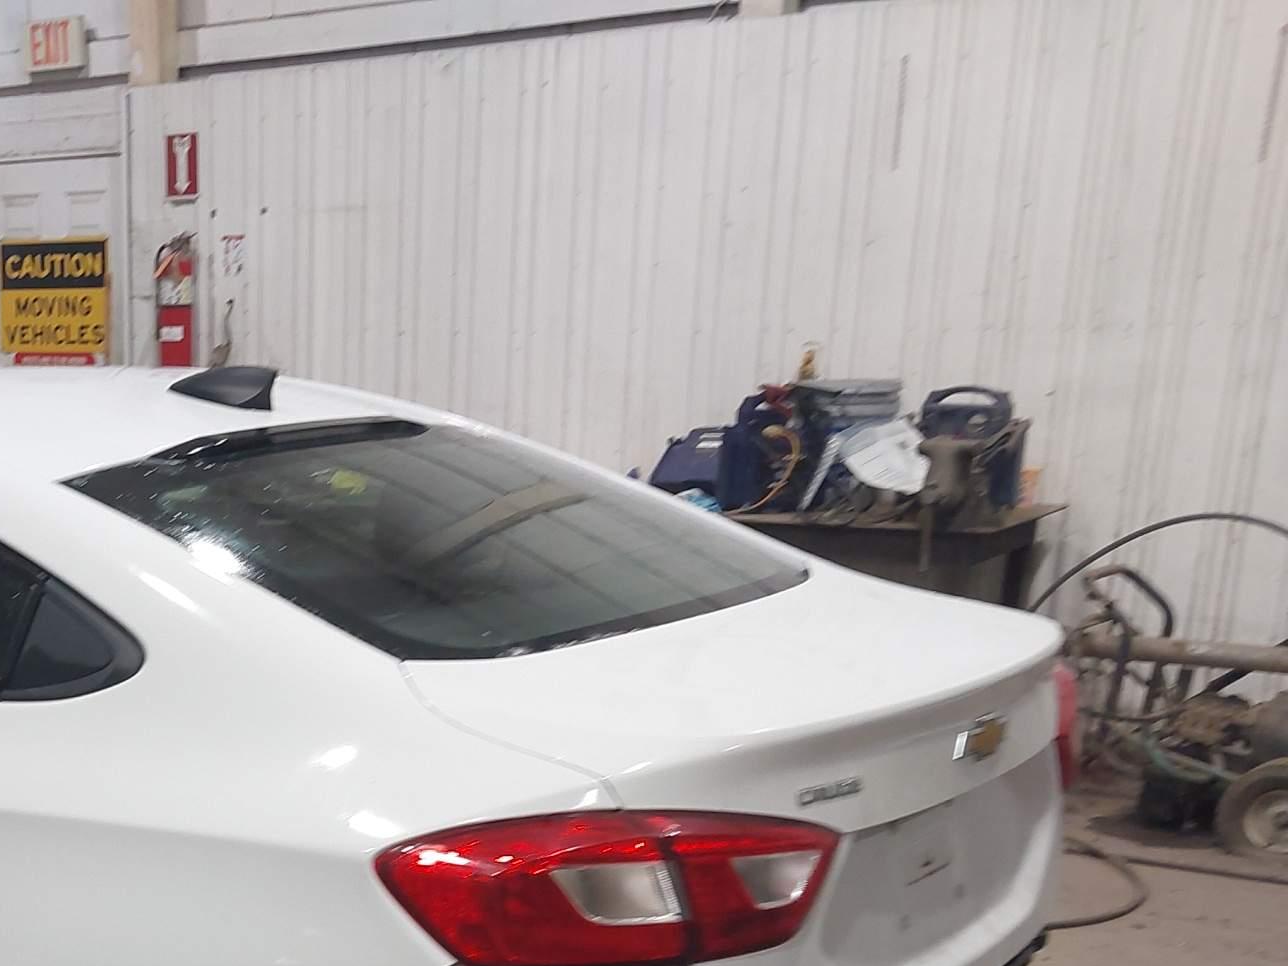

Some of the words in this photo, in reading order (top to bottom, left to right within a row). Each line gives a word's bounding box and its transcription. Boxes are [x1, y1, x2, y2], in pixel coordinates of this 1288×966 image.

[31, 19, 70, 66] EXIT
[4, 252, 103, 279] CAUTION
[15, 295, 92, 318] MOVING
[5, 323, 105, 345] VEHICLES
